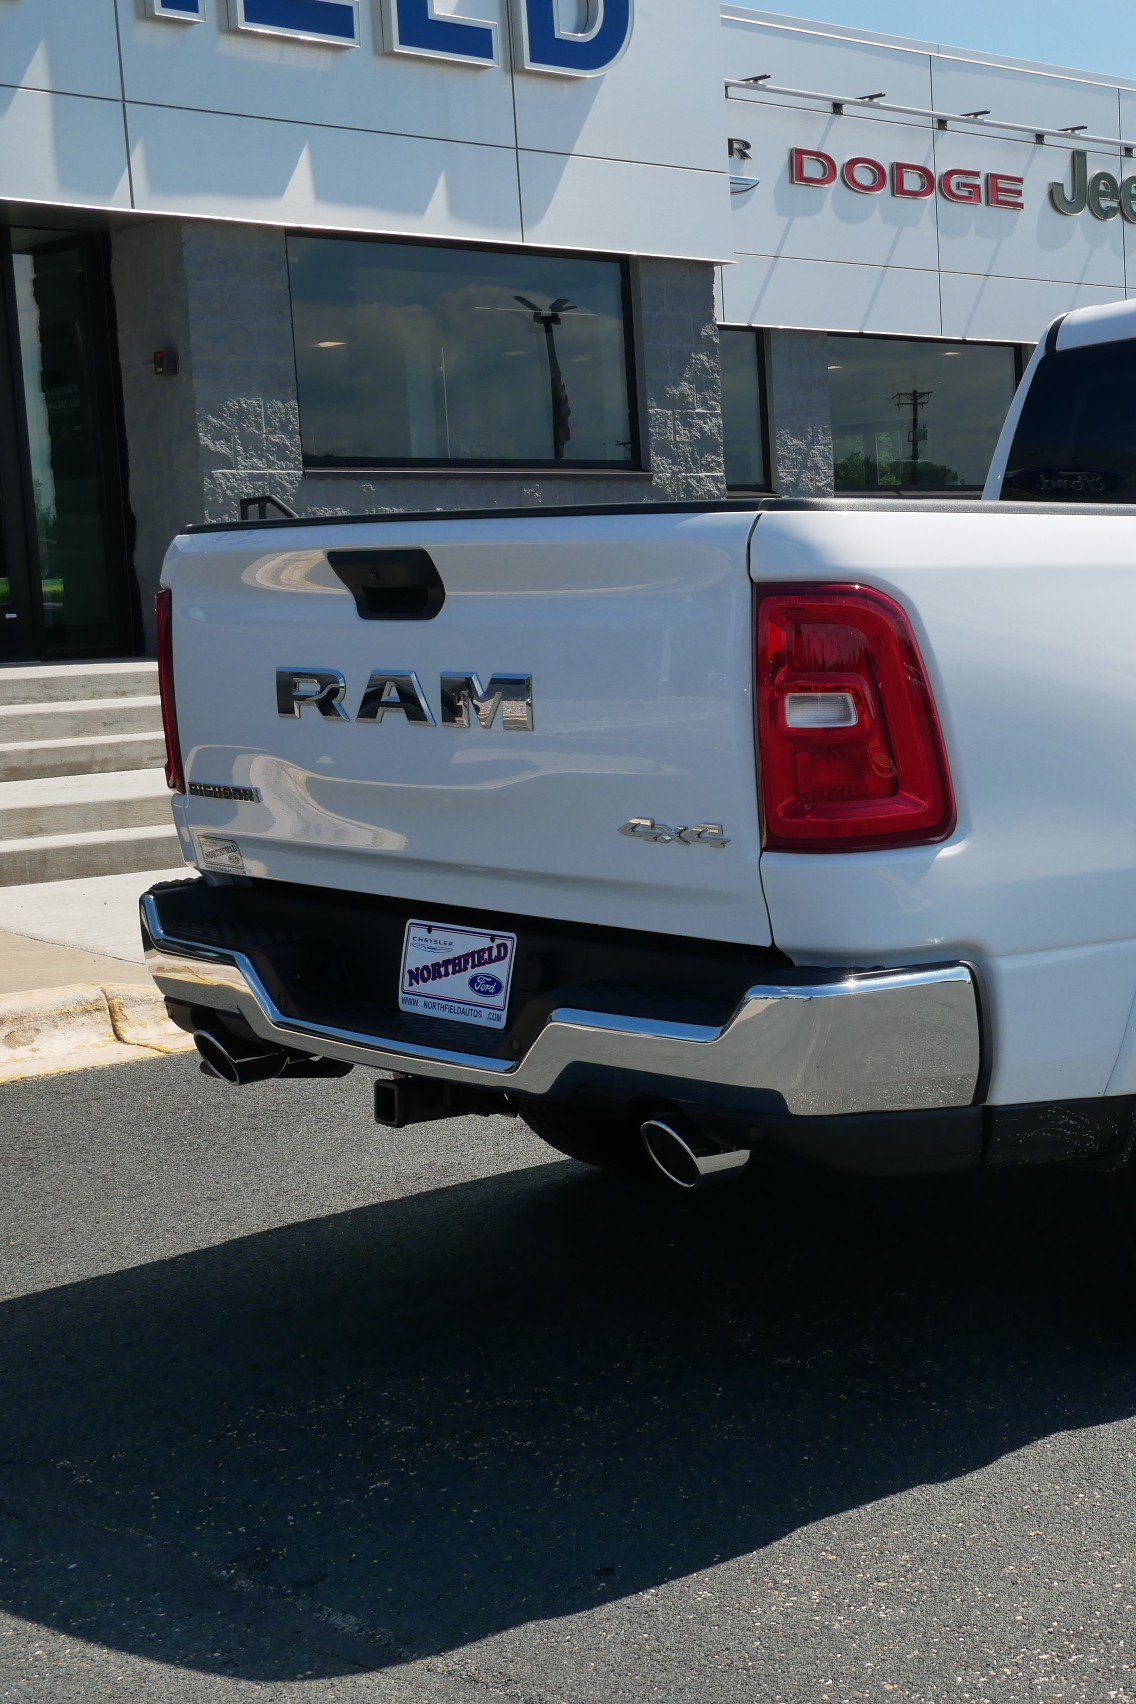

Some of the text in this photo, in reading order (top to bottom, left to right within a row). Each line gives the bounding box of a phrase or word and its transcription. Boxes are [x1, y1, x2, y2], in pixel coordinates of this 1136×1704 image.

[790, 146, 1025, 210] DODGE
[275, 666, 534, 731] RAM
[617, 817, 731, 848] 4x4
[205, 844, 239, 860] NORTHFIELD
[412, 936, 453, 947] CHRYSLER
[407, 942, 509, 987] NORTHFIELD
[474, 975, 498, 994] Ford
[401, 996, 420, 1008] WWW.
[423, 1000, 482, 1019] NORTHFIELDAUTOS
